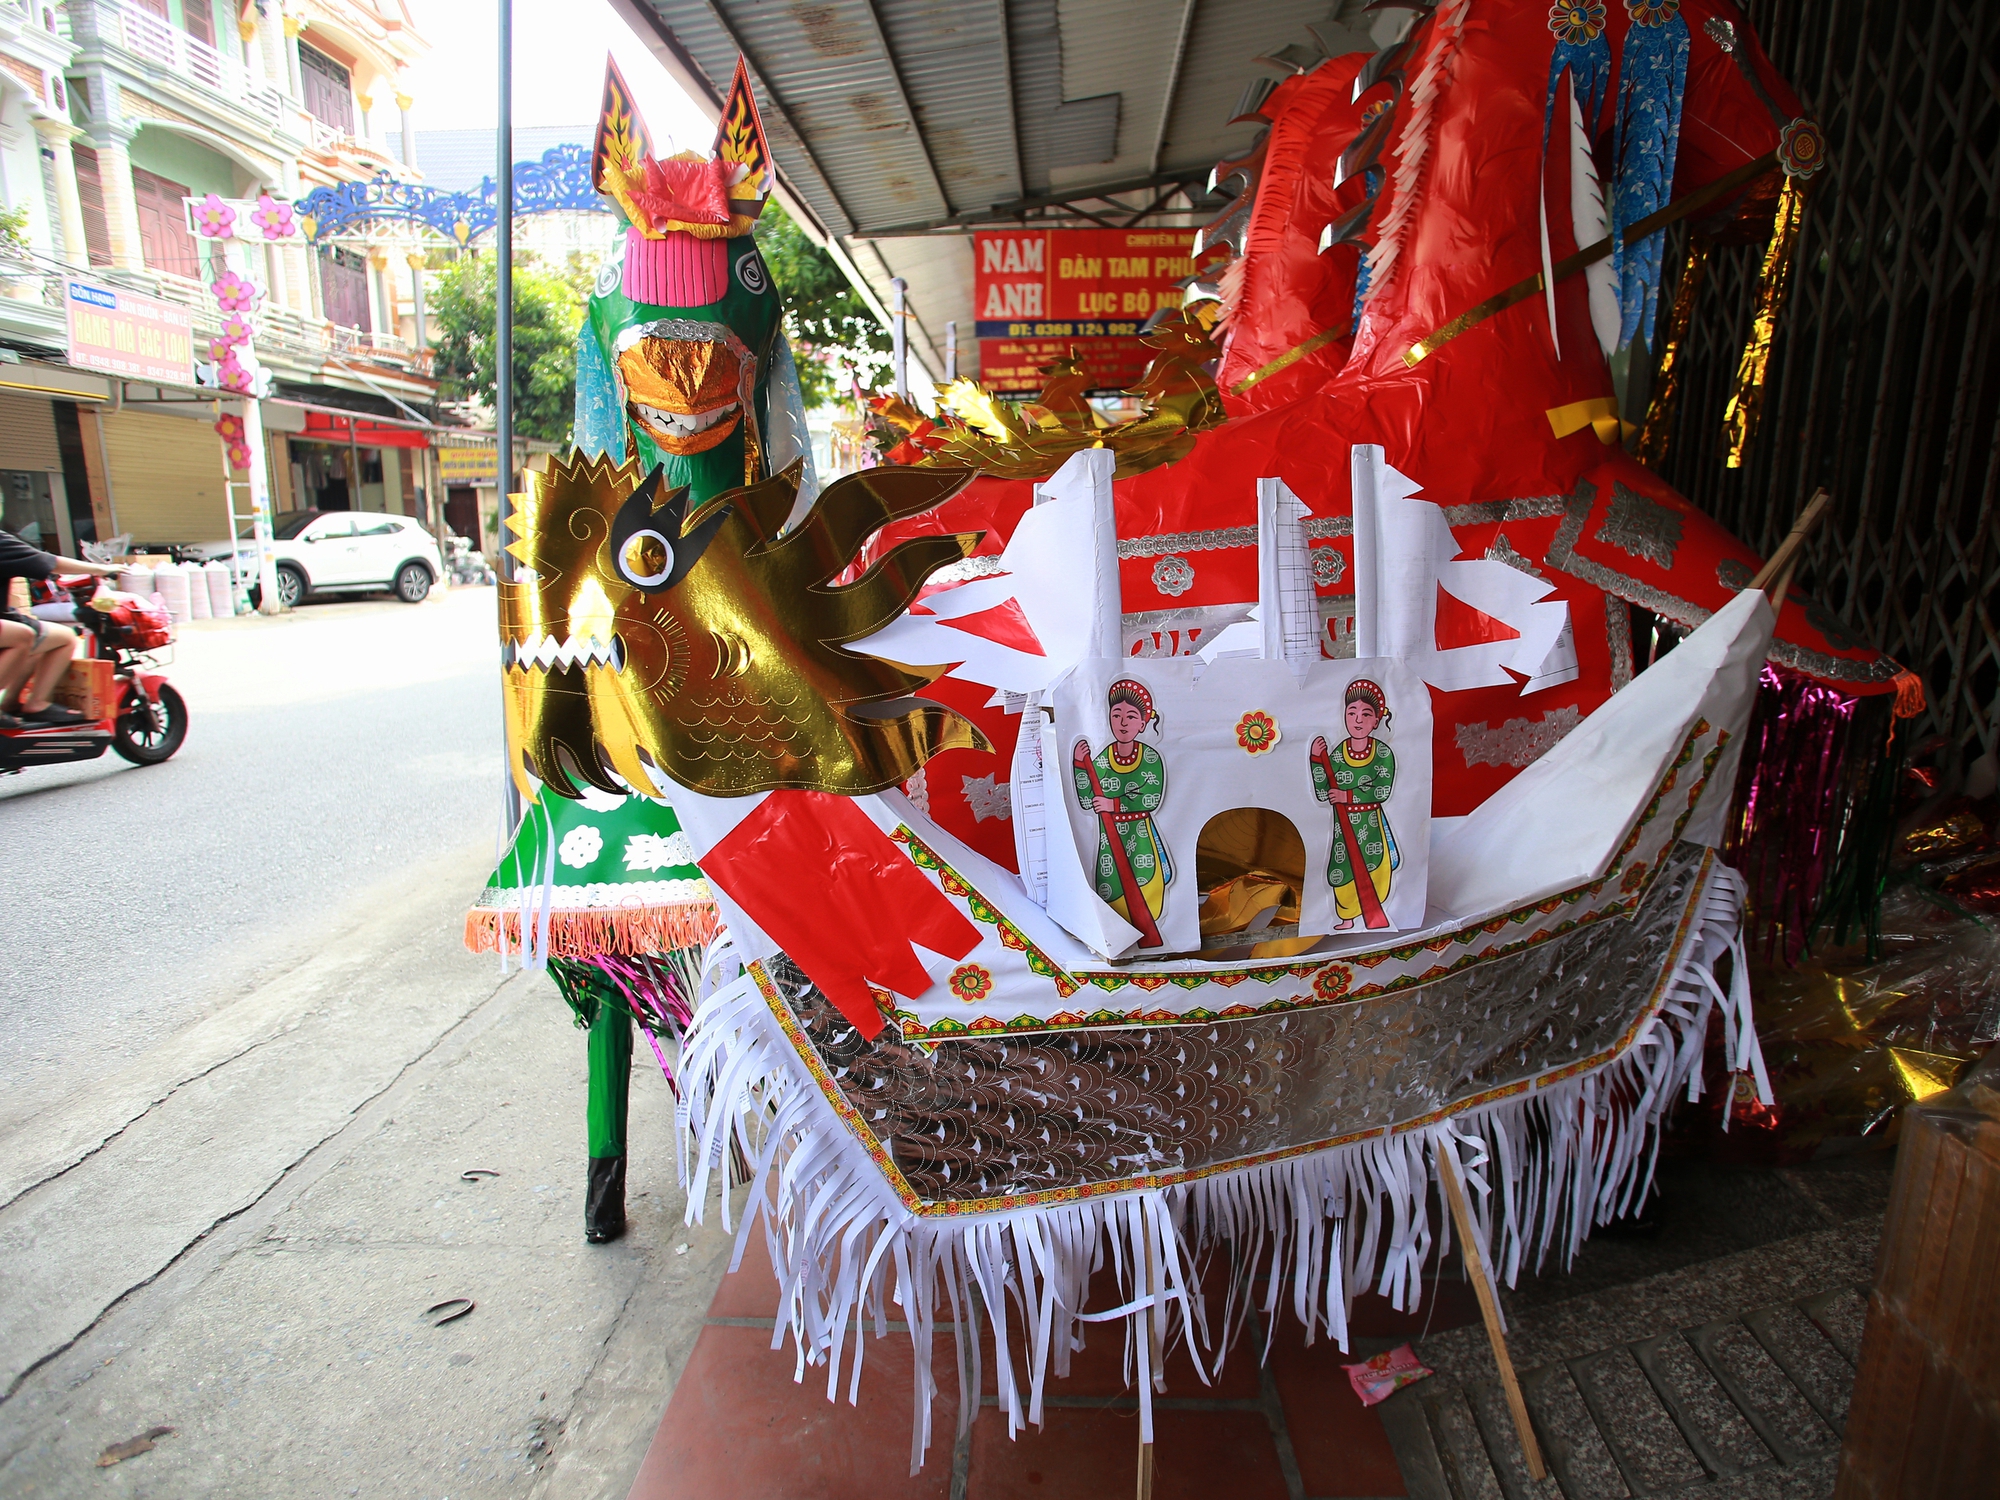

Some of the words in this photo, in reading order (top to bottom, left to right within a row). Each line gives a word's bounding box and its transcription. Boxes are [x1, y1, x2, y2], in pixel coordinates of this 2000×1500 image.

[982, 238, 1045, 273] NAM
[1108, 257, 1149, 278] TAM
[983, 283, 1044, 317] ANH
[1078, 292, 1118, 318] LỤC
[1123, 287, 1151, 317] BỘ
[73, 306, 112, 349] HÀNG
[113, 316, 136, 355] MÃ
[138, 320, 162, 359] CÁC
[164, 331, 189, 370] LOẠI
[1008, 323, 1032, 336] ĐT:
[1035, 323, 1073, 336] 0368
[1077, 323, 1105, 336] 124
[1108, 323, 1137, 335] 992
